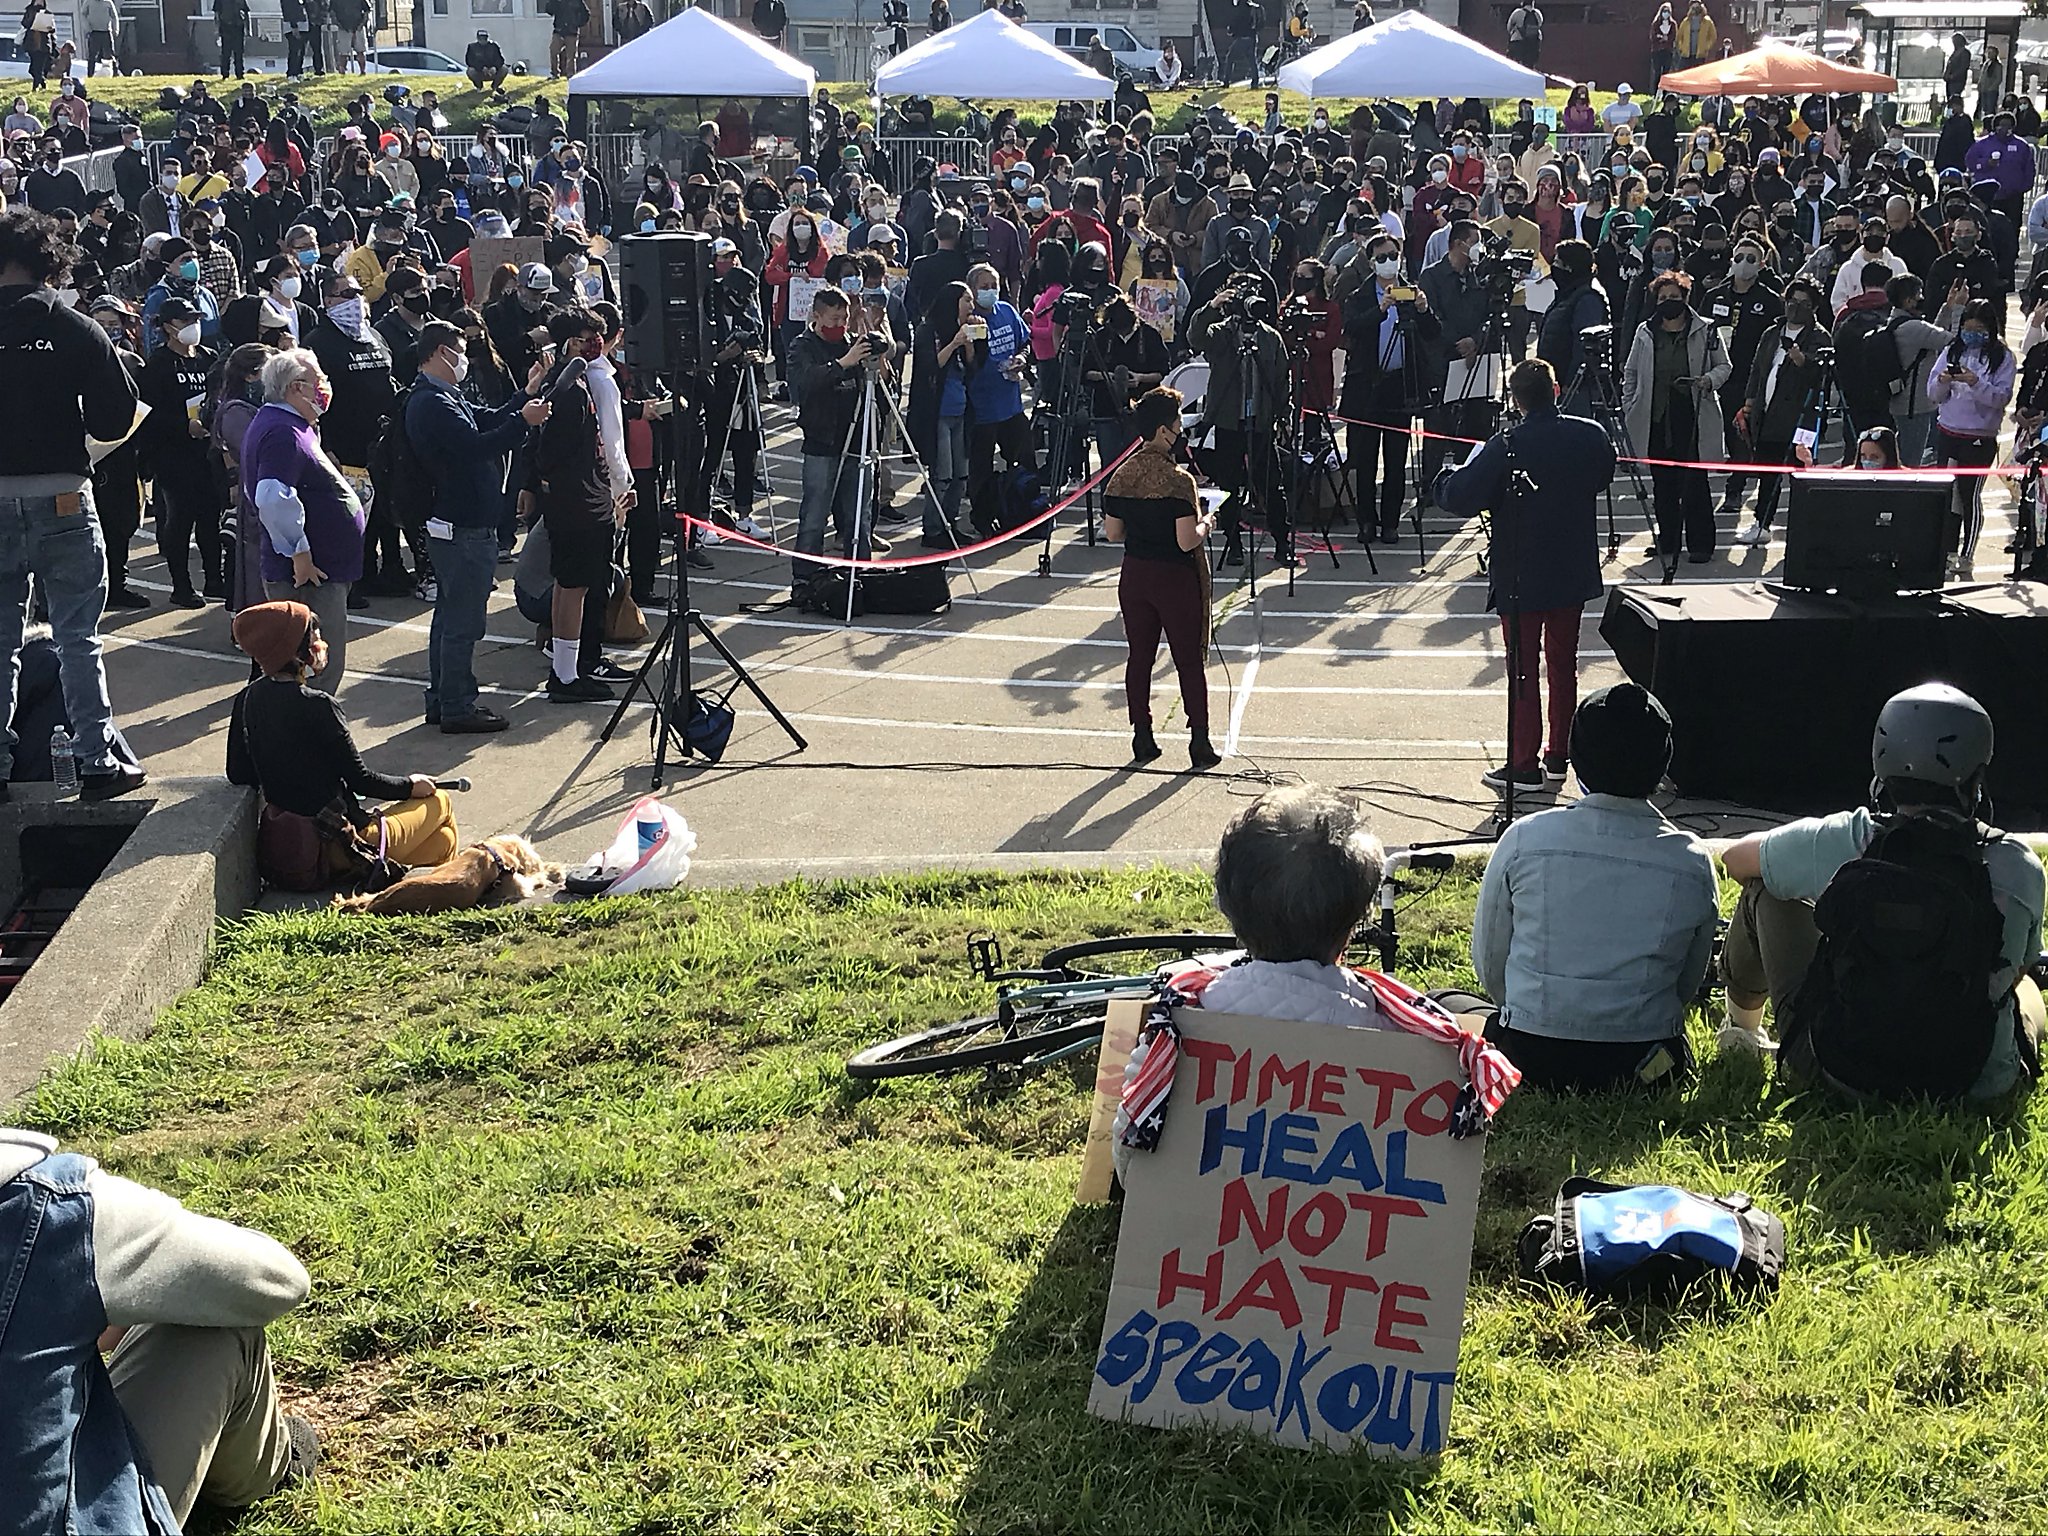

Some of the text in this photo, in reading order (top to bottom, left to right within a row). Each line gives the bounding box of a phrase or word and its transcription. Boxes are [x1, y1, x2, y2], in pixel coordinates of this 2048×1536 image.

[176, 372, 206, 384] DKN
[593, 665, 609, 676] N
[1183, 1038, 1460, 1137] TIME TO
[1199, 1104, 1447, 1205] HEAL
[1217, 1177, 1429, 1261] NOT
[1156, 1248, 1432, 1354] HATE
